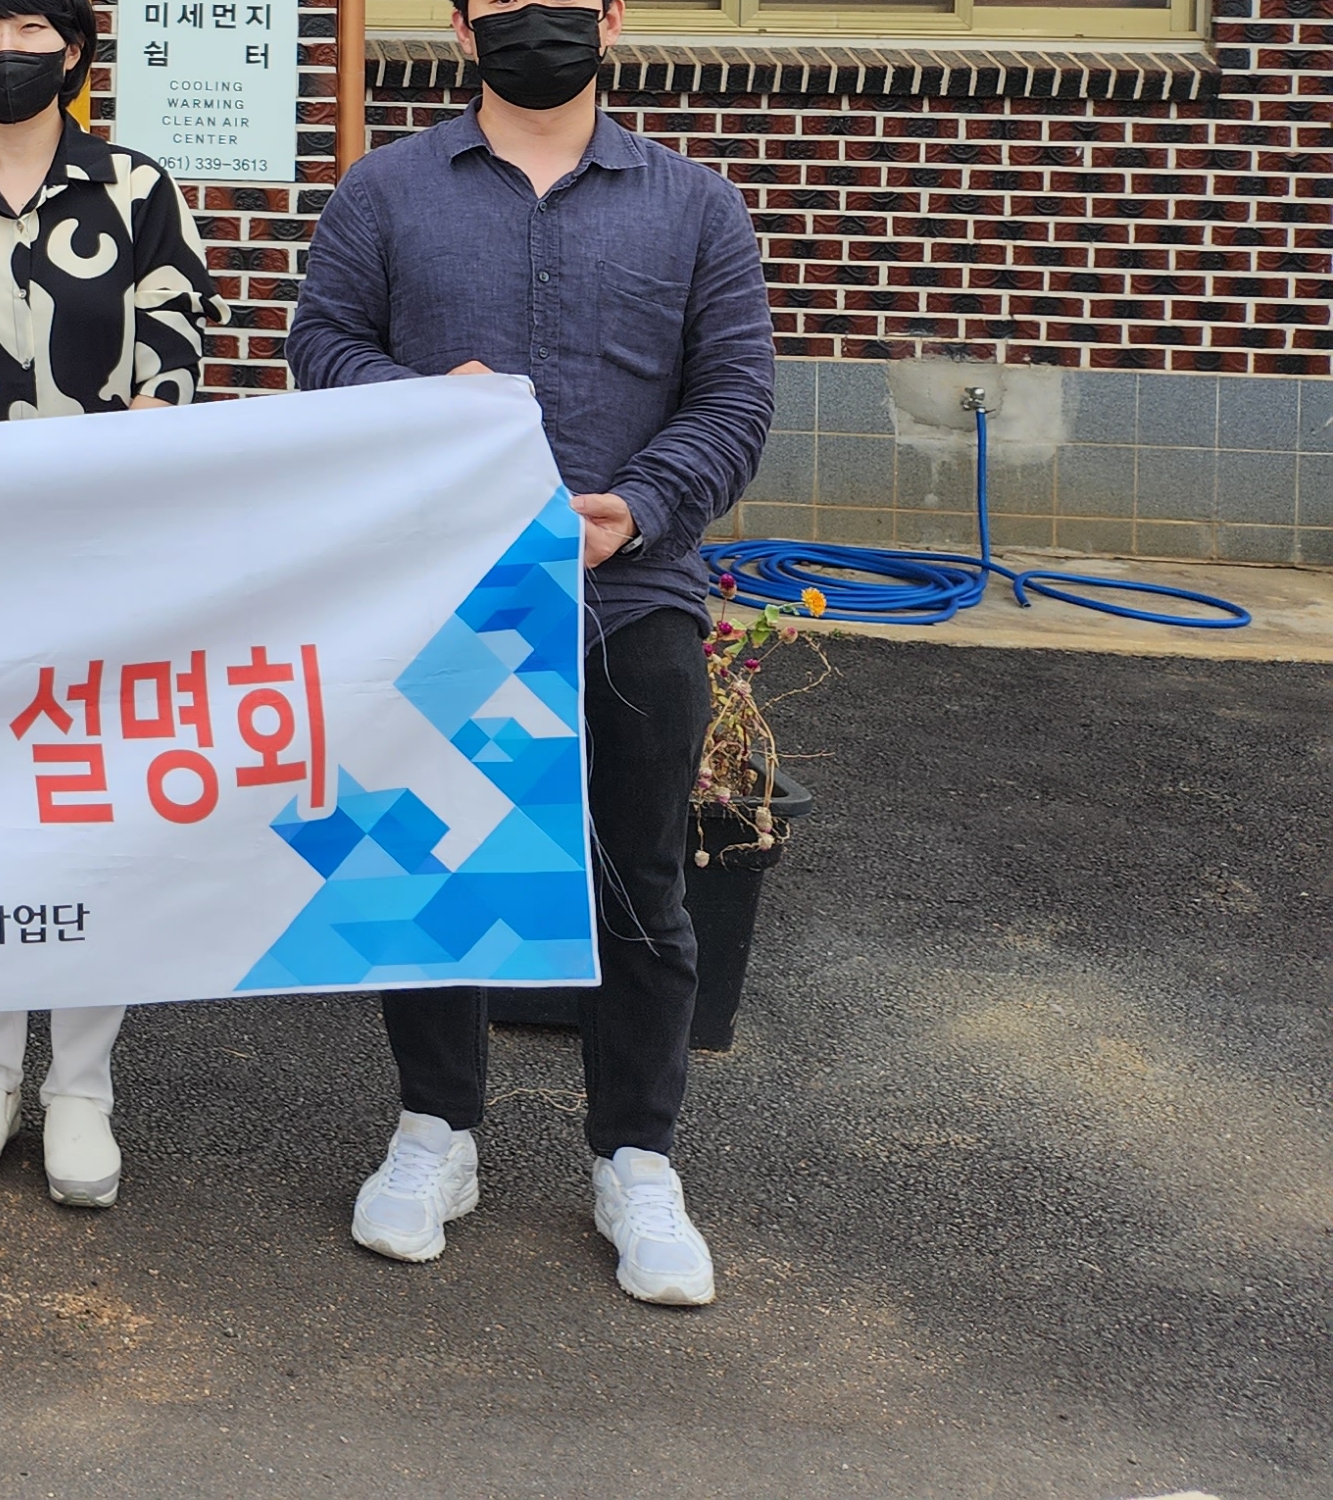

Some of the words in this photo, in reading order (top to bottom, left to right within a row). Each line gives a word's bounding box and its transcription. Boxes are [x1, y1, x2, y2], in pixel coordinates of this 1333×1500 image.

[144, 2, 271, 30] 미세먼지
[169, 80, 243, 92] COOLING
[167, 98, 245, 110] WARMING
[161, 116, 216, 127] CLEAN
[222, 117, 250, 128] AIR
[173, 133, 238, 145] CENTER
[195, 157, 268, 172] 339-3613
[9, 643, 327, 825] 설명회
